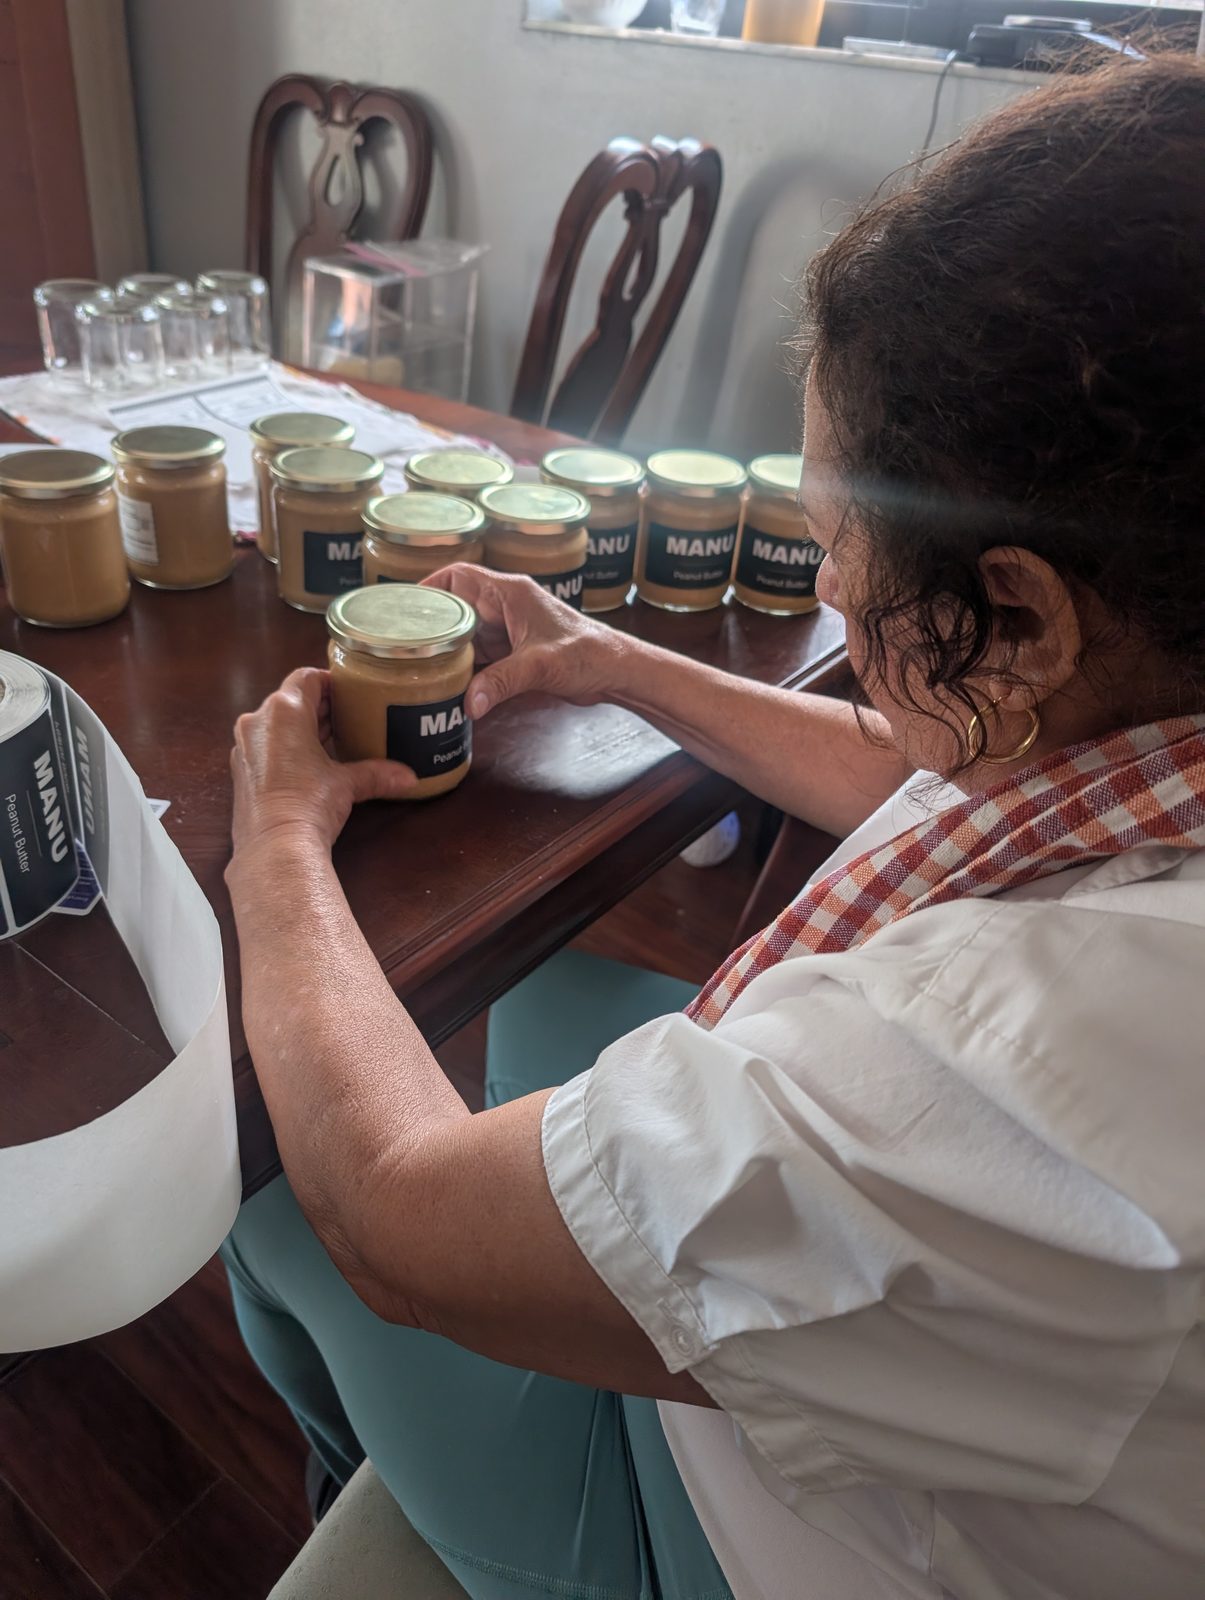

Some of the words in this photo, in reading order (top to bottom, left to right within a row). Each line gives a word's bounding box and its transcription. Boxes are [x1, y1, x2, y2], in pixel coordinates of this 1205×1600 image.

[666, 533, 735, 558] MANU
[752, 538, 823, 566] MANU
[433, 745, 463, 765] Peanut
[5, 793, 24, 839] Peanut
[33, 749, 69, 864] MANU
[14, 836, 30, 874] Butter
